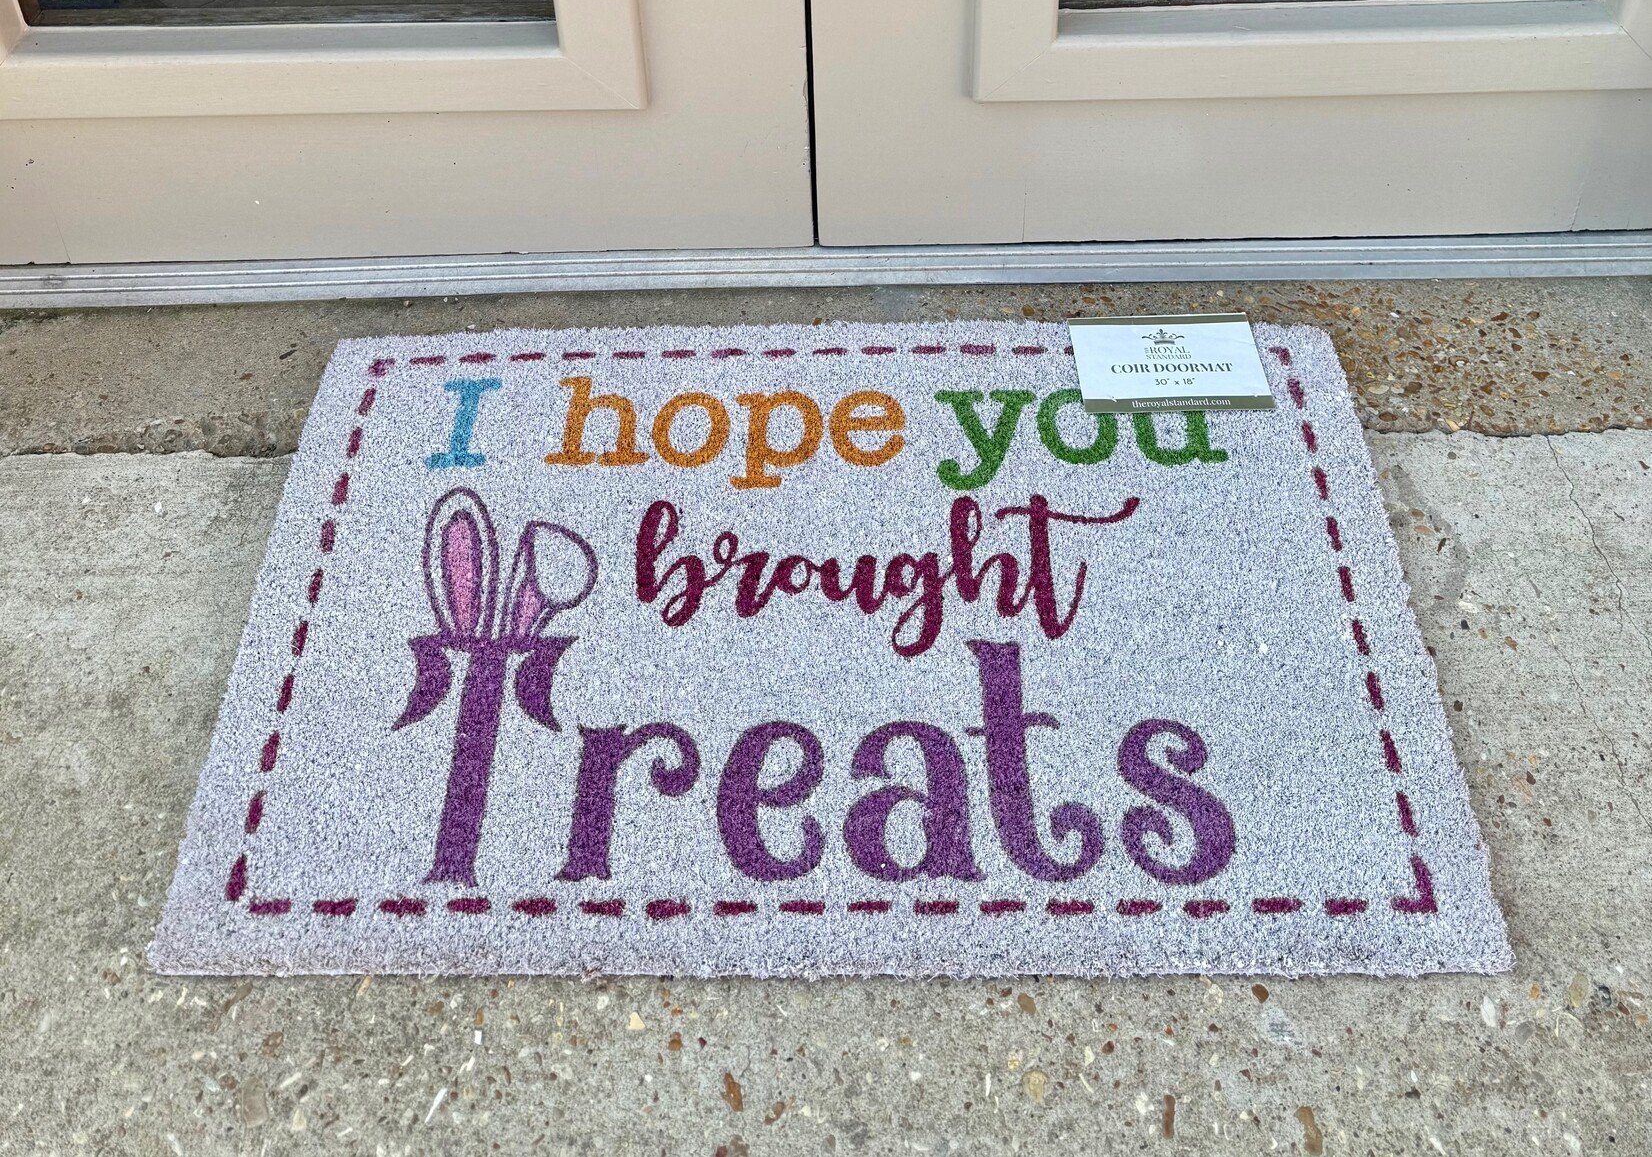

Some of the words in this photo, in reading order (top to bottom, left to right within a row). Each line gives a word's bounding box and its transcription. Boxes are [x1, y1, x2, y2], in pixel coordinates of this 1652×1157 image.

[1111, 364, 1150, 374] COIR
[1154, 362, 1233, 373] DOORMAT
[1149, 346, 1190, 354] ROYAL
[424, 377, 500, 469] I
[544, 376, 906, 489] hope
[934, 388, 1229, 490] you
[1131, 397, 1231, 409] theroyalstandard.com
[635, 494, 1140, 658] brought
[391, 637, 1238, 886] Treats
